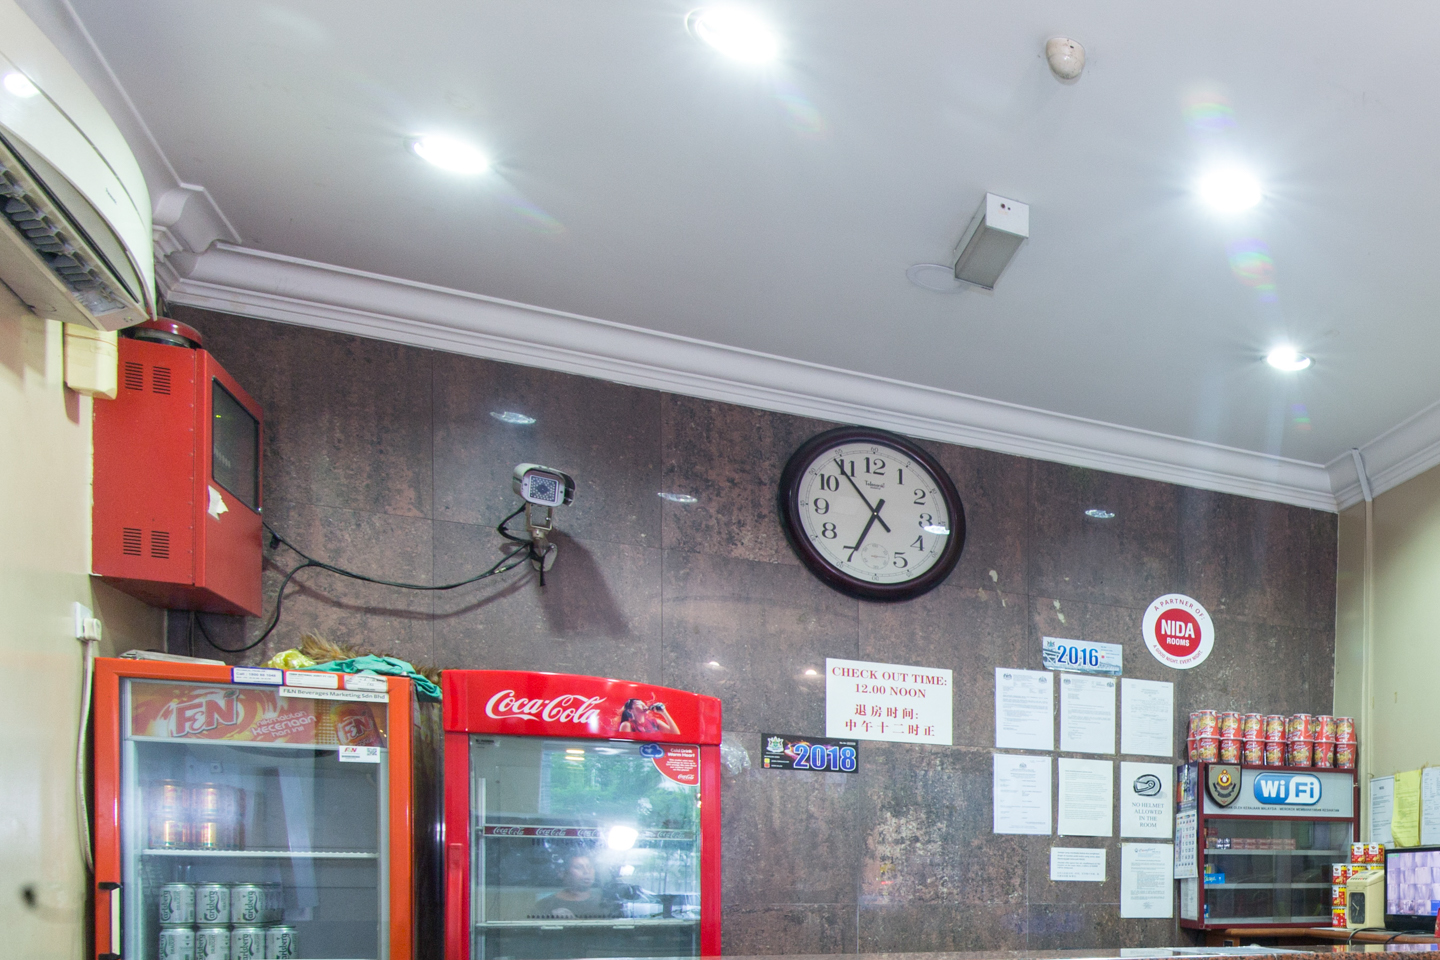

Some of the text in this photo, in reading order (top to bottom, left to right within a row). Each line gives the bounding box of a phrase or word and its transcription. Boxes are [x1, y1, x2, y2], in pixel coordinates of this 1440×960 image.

[838, 458, 857, 478] 11
[863, 457, 886, 476] 12
[818, 473, 840, 492] 10
[897, 468, 905, 486] 1
[913, 488, 927, 506] 2
[813, 498, 830, 515] 9
[918, 513, 933, 528] 3
[821, 522, 838, 540] 8
[910, 535, 925, 552] 4
[843, 545, 859, 563] 7
[893, 552, 909, 568] 5
[1160, 598, 1194, 610] PARTNER
[1161, 619, 1195, 639] NIDA
[1166, 637, 1190, 647] ROOMS
[1057, 644, 1099, 667] 2016
[832, 666, 948, 686] CHECK OUT TIME:
[298, 689, 328, 698] Beverages
[330, 691, 361, 700] Marketing
[855, 683, 927, 698] 12.00 NOON
[172, 693, 239, 738] F&N
[485, 690, 607, 724] Coca-Cola
[845, 718, 936, 737] 中午十二时正
[793, 744, 857, 772] 2018
[204, 890, 220, 922] Carlsberg
[243, 890, 258, 922] Carlsberg
